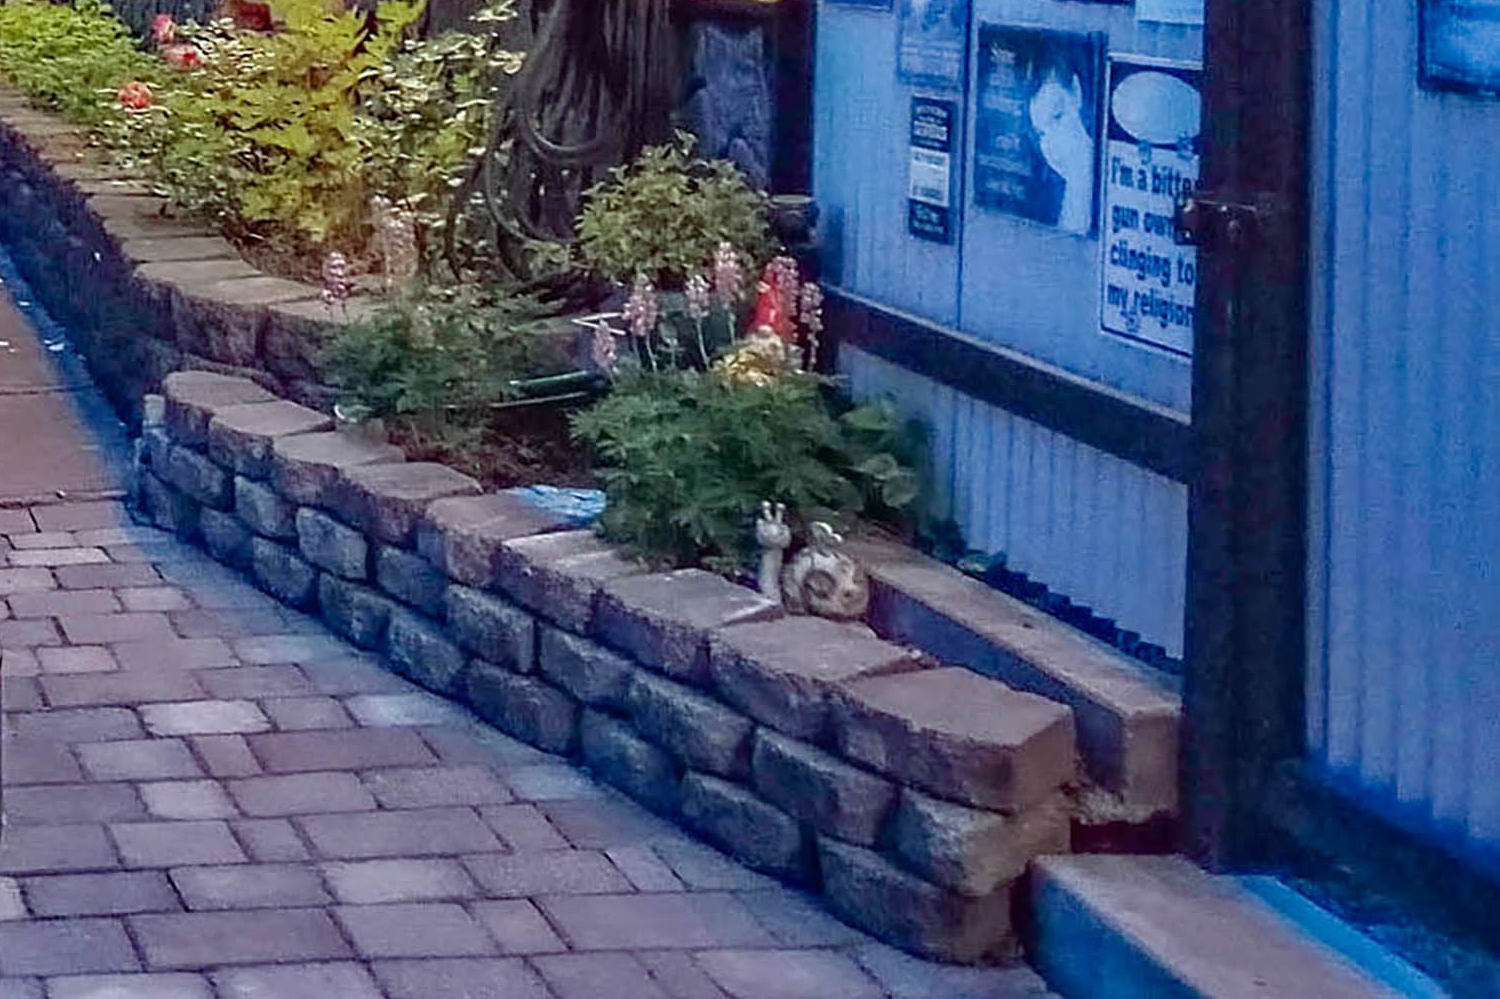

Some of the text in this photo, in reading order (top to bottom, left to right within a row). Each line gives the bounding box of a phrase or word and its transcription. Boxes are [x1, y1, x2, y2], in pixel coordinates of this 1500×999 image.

[1111, 155, 1134, 188] I'm
[1137, 168, 1148, 191] a
[1111, 204, 1139, 233] gun
[1110, 238, 1195, 288] clinging to
[1107, 283, 1130, 318] my
